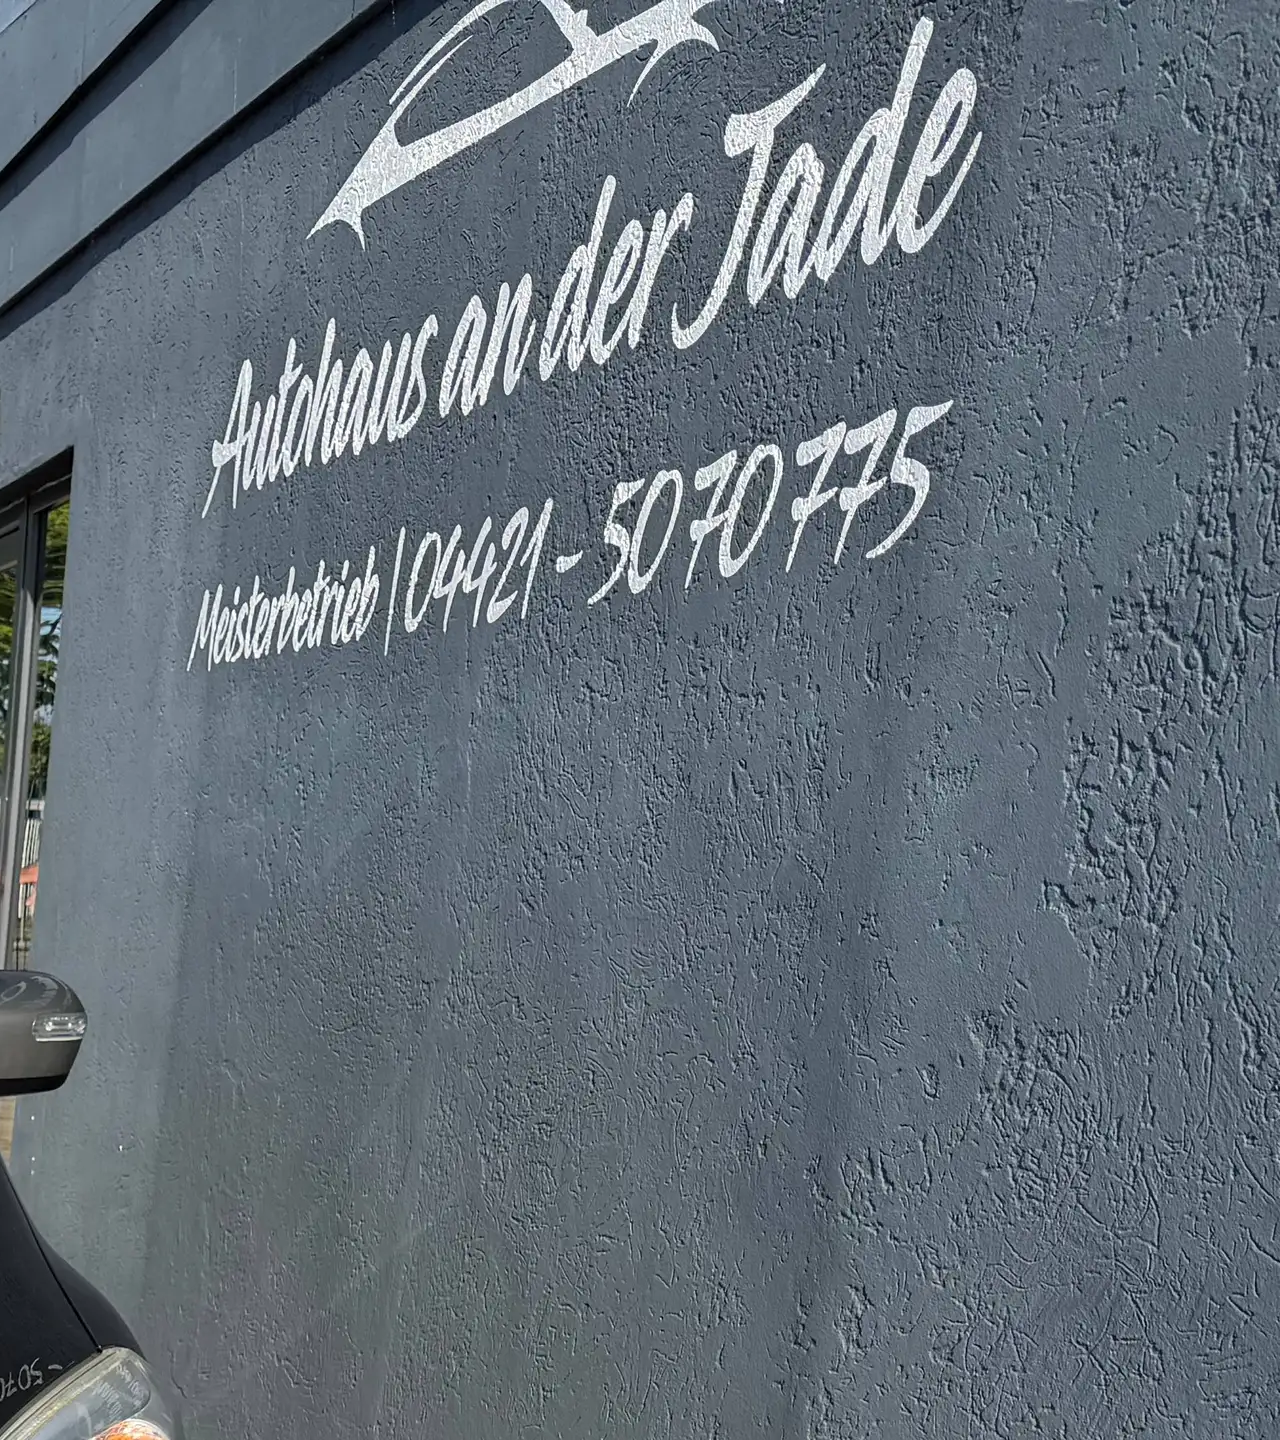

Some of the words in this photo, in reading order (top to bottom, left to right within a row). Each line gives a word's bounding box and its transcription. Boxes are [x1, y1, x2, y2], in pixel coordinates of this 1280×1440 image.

[201, 314, 439, 518] Autohaus
[439, 272, 535, 417] an
[540, 175, 694, 381] der
[671, 17, 982, 350] Jade
[187, 545, 381, 672] Meisterbetrieb
